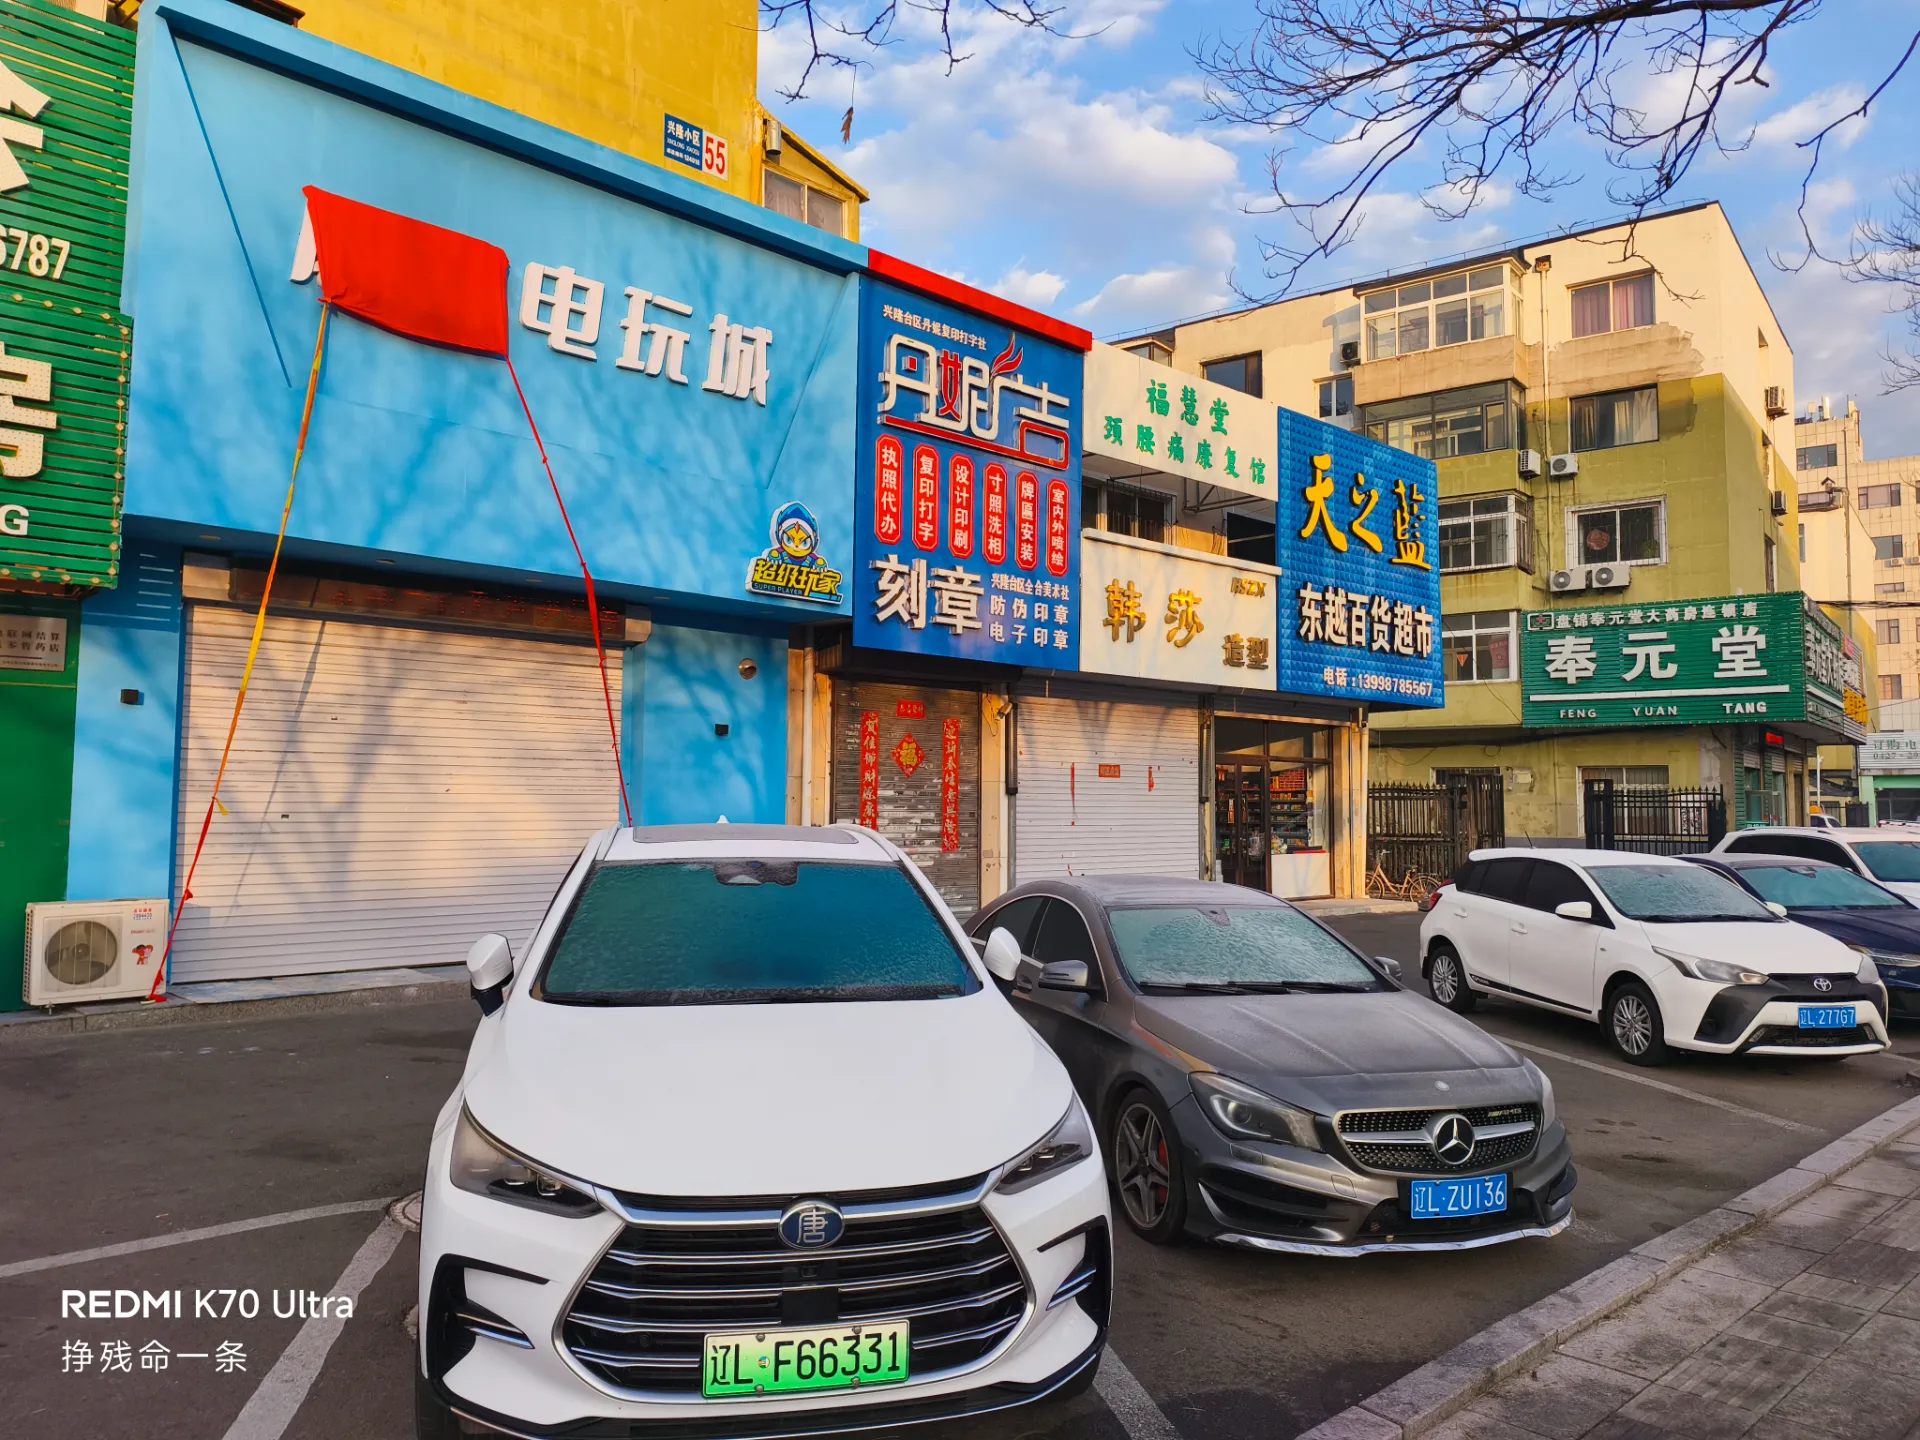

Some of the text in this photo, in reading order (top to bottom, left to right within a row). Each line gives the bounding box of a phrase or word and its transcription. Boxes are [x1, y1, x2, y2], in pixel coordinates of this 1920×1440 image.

[667, 120, 700, 147] 兴隆小区
[705, 135, 725, 174] 55
[0, 224, 70, 280] 787
[518, 261, 772, 406] 电玩城
[1146, 379, 1230, 436] 福慧堂
[880, 445, 899, 535] 执照代办
[918, 454, 935, 542] 复印打字
[953, 464, 970, 550] 设计印刷
[987, 473, 1003, 556] 寸照洗相
[1020, 480, 1034, 563] 牌匾安装
[1051, 488, 1065, 567] 室内外喷绘
[753, 559, 841, 597] 超级玩家
[753, 583, 802, 595] SUPER PLAYER
[869, 553, 985, 635] 刻章
[989, 594, 1069, 625] 防伪印章
[989, 621, 1069, 650] 电子印章
[1103, 578, 1204, 648] 韩莎
[1297, 581, 1434, 659] 东越百货超市
[1221, 633, 1269, 670] 造型
[1544, 624, 1768, 685] 奉元堂
[1559, 701, 1767, 718] FENG YUAN TANG
